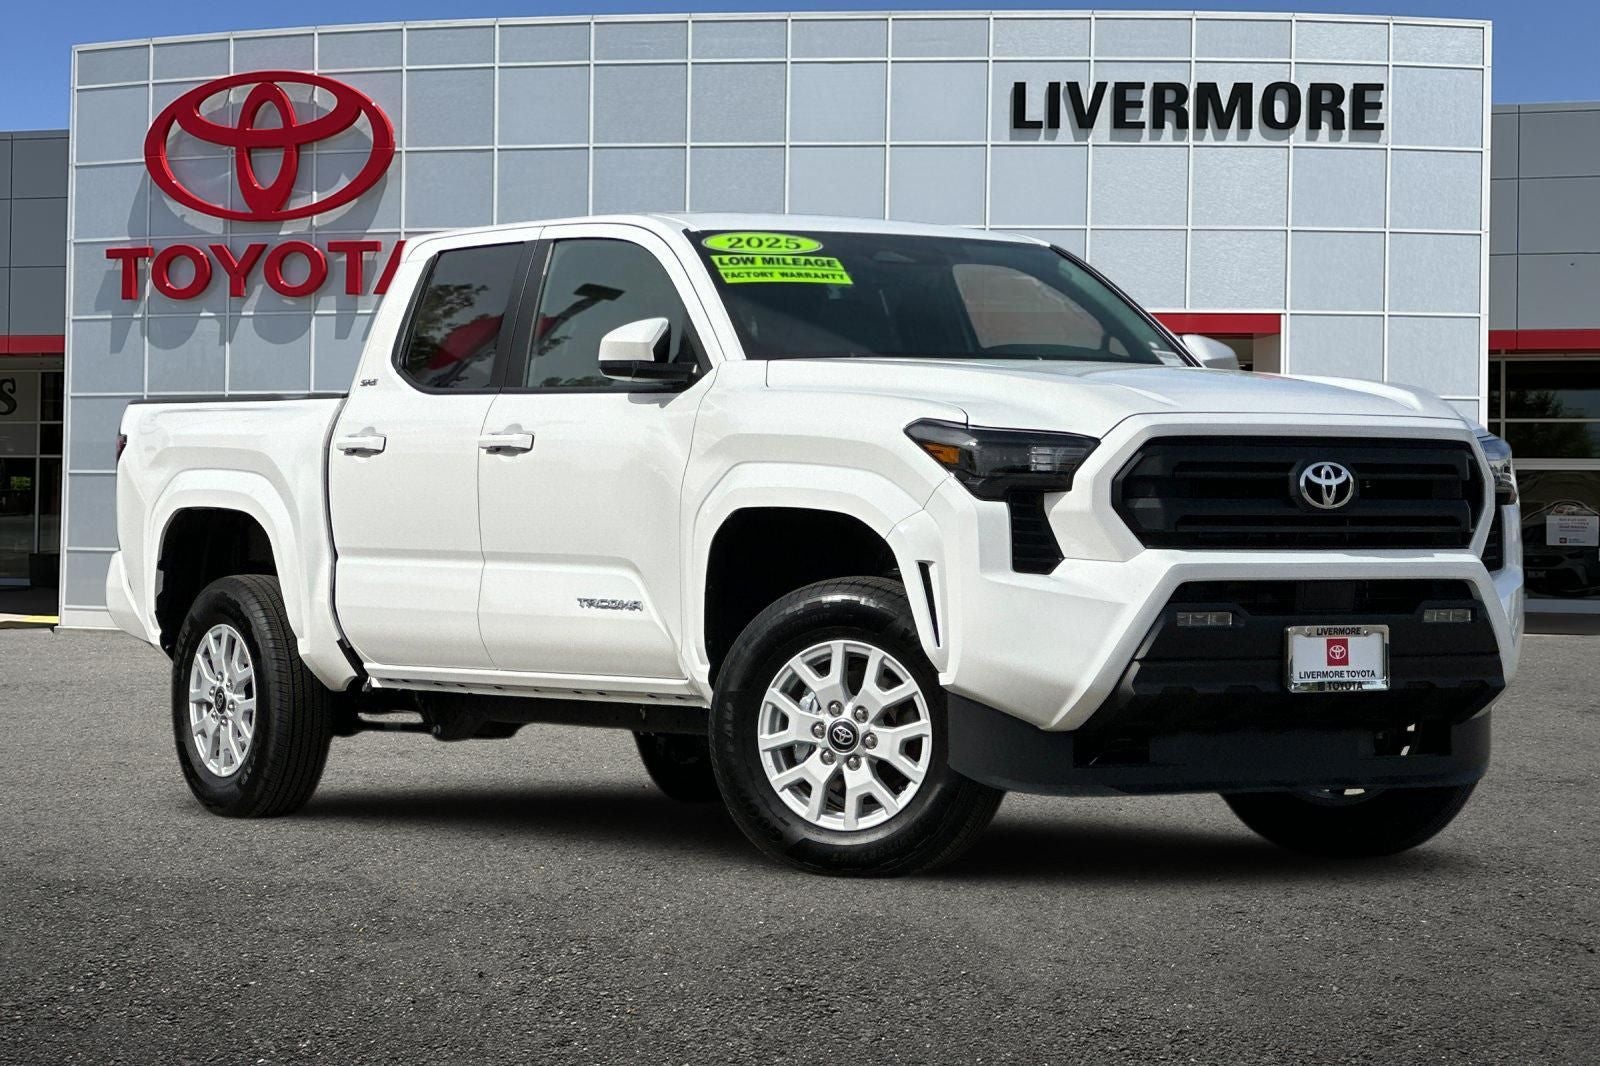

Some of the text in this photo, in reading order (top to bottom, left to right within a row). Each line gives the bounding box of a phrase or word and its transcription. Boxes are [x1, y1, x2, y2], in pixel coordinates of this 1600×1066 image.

[1012, 80, 1385, 132] LIVERMORE
[726, 236, 802, 250] 2025
[717, 256, 836, 268] LOW MILEAGE
[723, 271, 845, 280] FACTORY WARRANTY
[1316, 626, 1362, 636] LIVERMORE
[1298, 669, 1377, 680] LIVERMORE TOYOTA
[1326, 681, 1363, 691] TOYOTA
